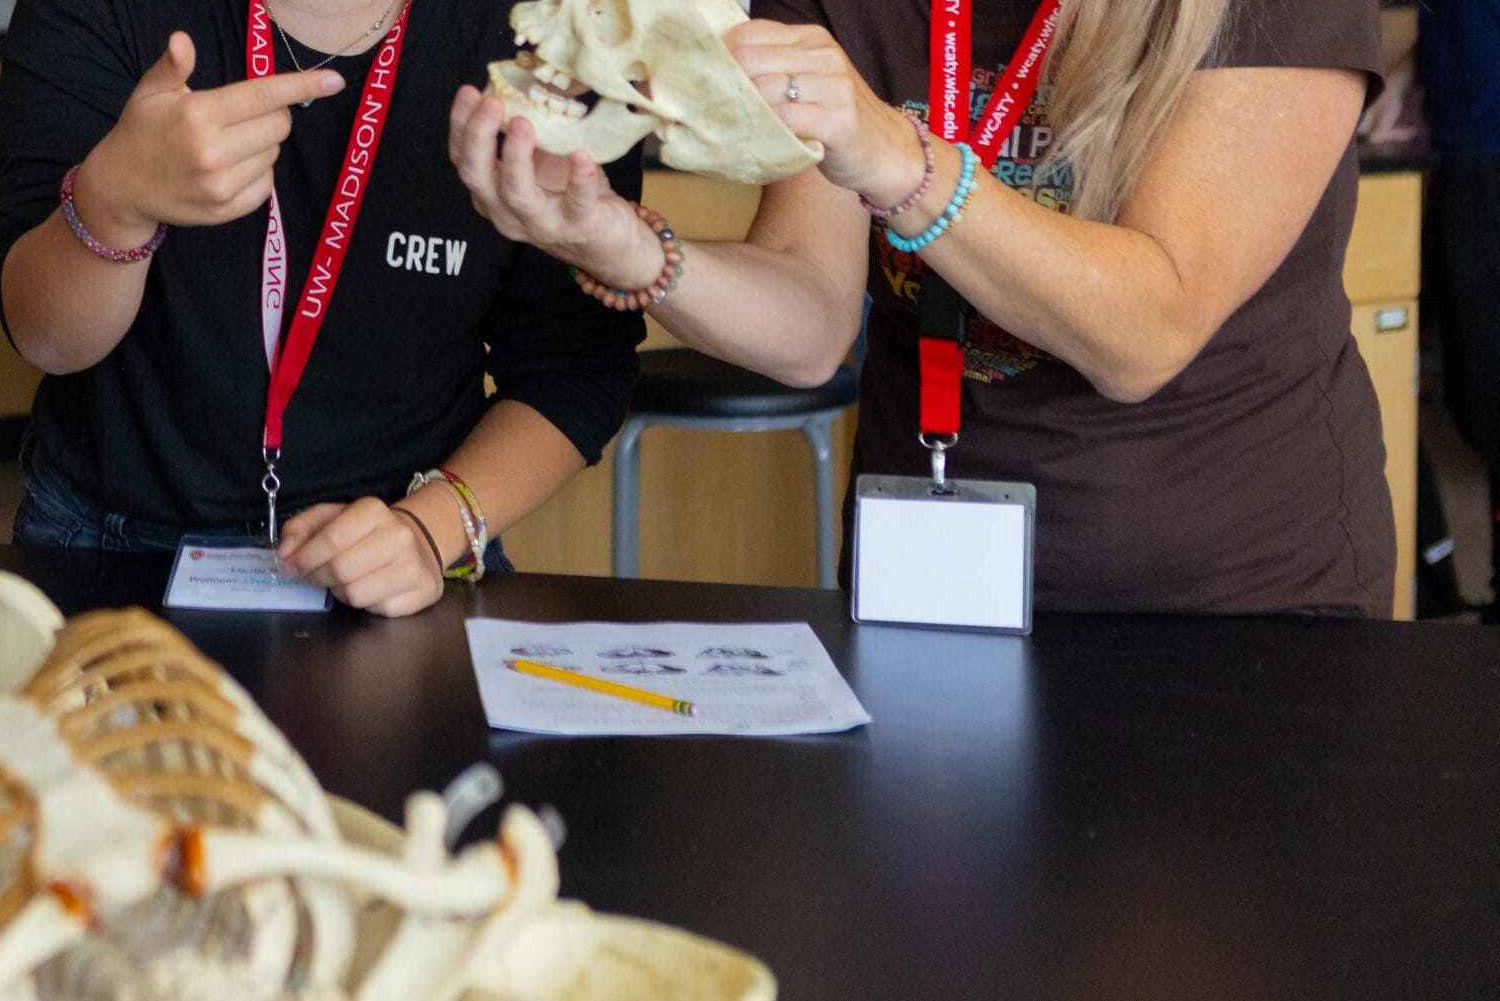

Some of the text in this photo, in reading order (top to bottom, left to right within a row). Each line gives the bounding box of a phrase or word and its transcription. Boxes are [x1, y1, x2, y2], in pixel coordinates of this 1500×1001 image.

[943, 32, 960, 139] wcaty.wisc.edu
[978, 92, 1015, 146] WCATY
[387, 232, 467, 276] CREW
